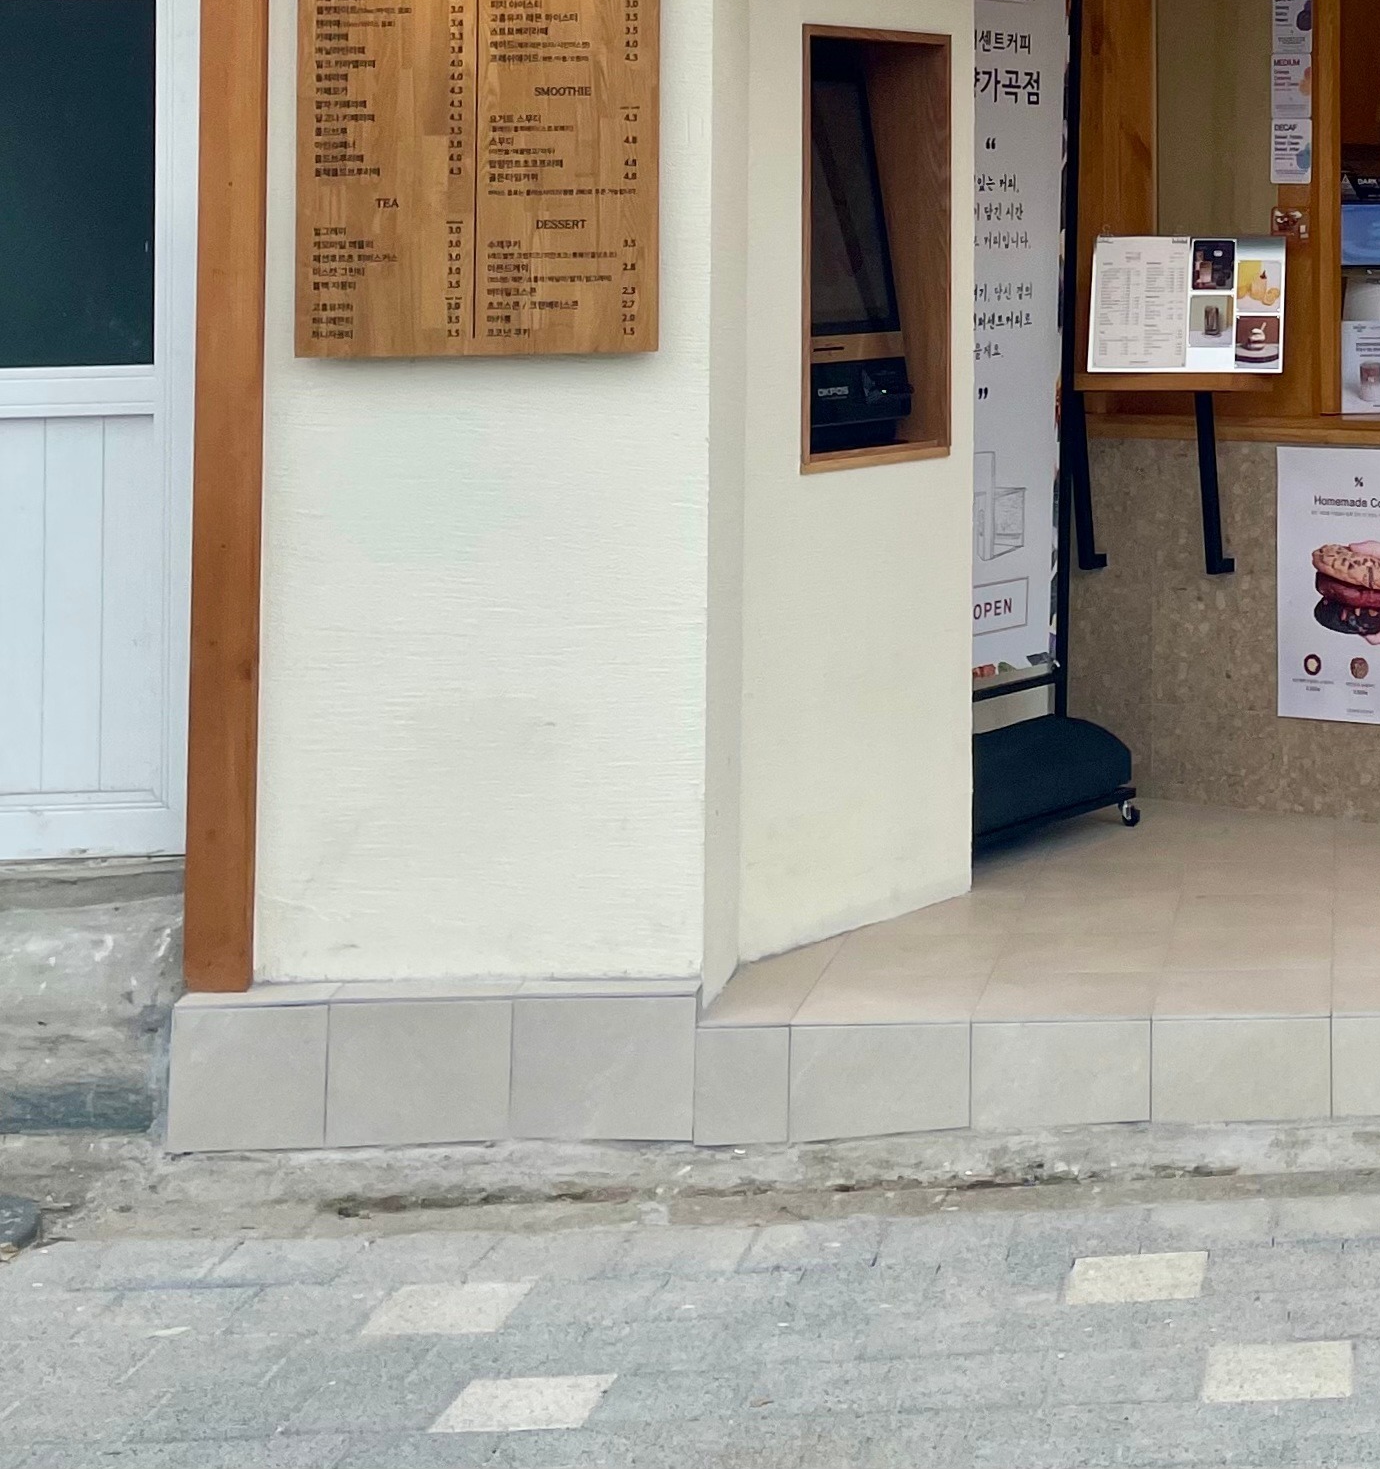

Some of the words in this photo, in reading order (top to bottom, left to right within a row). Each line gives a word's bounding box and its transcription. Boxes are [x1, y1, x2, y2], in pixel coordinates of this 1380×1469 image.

[625, 0, 640, 9] 3.0
[450, 6, 464, 15] 3.0
[625, 13, 639, 22] 3.5
[974, 30, 1032, 56] 센트커피
[450, 46, 464, 55] 3.8
[449, 60, 464, 68] 4.0
[1273, 59, 1300, 67] MEDIUM
[449, 73, 464, 82] 4.0
[449, 87, 464, 95] 4.3
[534, 86, 592, 97] SMOOTHIE
[1274, 124, 1297, 132] DECAF
[374, 197, 400, 209] TEA
[1005, 204, 1024, 221] 시간
[536, 219, 588, 230] DESSERT
[984, 230, 1031, 251] 커피입니다.
[621, 287, 636, 295] 2.3
[621, 300, 635, 309] 2.7
[621, 314, 636, 322] 2.0
[974, 311, 1033, 330] 퍼센트커피로
[622, 327, 635, 336] 1.5
[1313, 495, 1367, 508] Homemade
[973, 598, 1012, 620] OPEN
